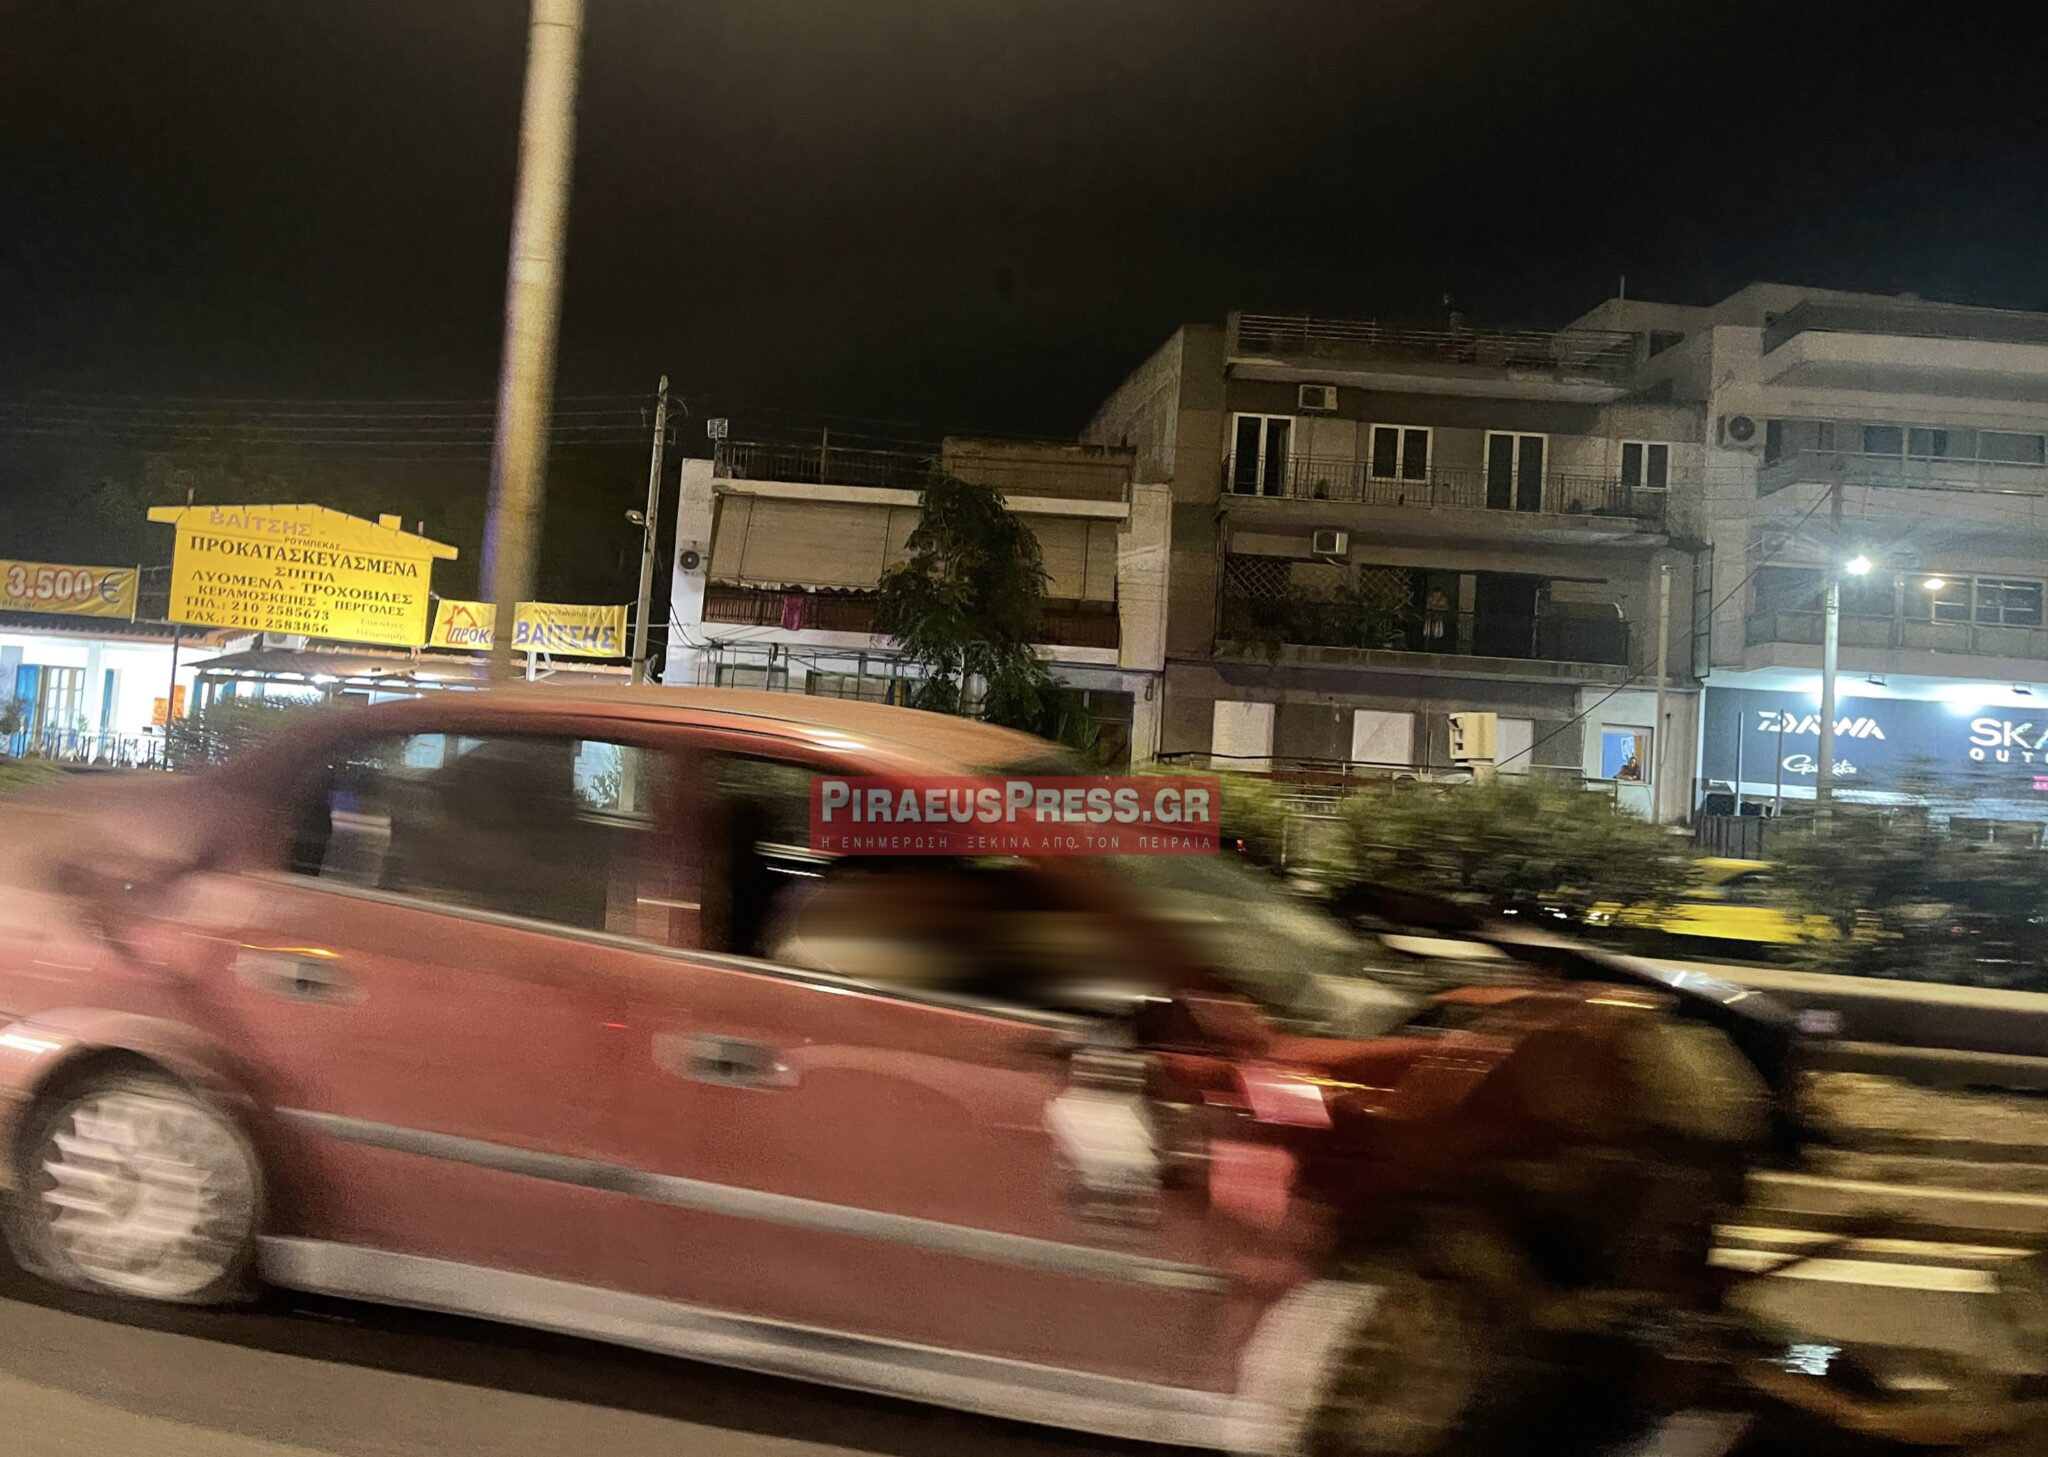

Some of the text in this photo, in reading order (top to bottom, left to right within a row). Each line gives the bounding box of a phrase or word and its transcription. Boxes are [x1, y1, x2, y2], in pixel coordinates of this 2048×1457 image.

[190, 536, 418, 577] ΠΡΟΚΑΤΑΣΚΕΥΑΣΜΕΝΑ
[191, 570, 283, 590] ΛΥΟΜΕΝΑ
[301, 582, 413, 604] ΤΡΟΧΟΒΙΛΕΣ
[274, 566, 335, 583] ΣΠΙΤΙΑ
[199, 585, 316, 607] ΚΕΡΑΜΟΣΚΕΠΕΣ
[334, 600, 405, 617] ΠΕΡΓΟΛΕΣ
[231, 600, 260, 612] 210
[266, 604, 330, 620] 2585673
[231, 614, 260, 627] 210
[264, 618, 329, 634] 2583856
